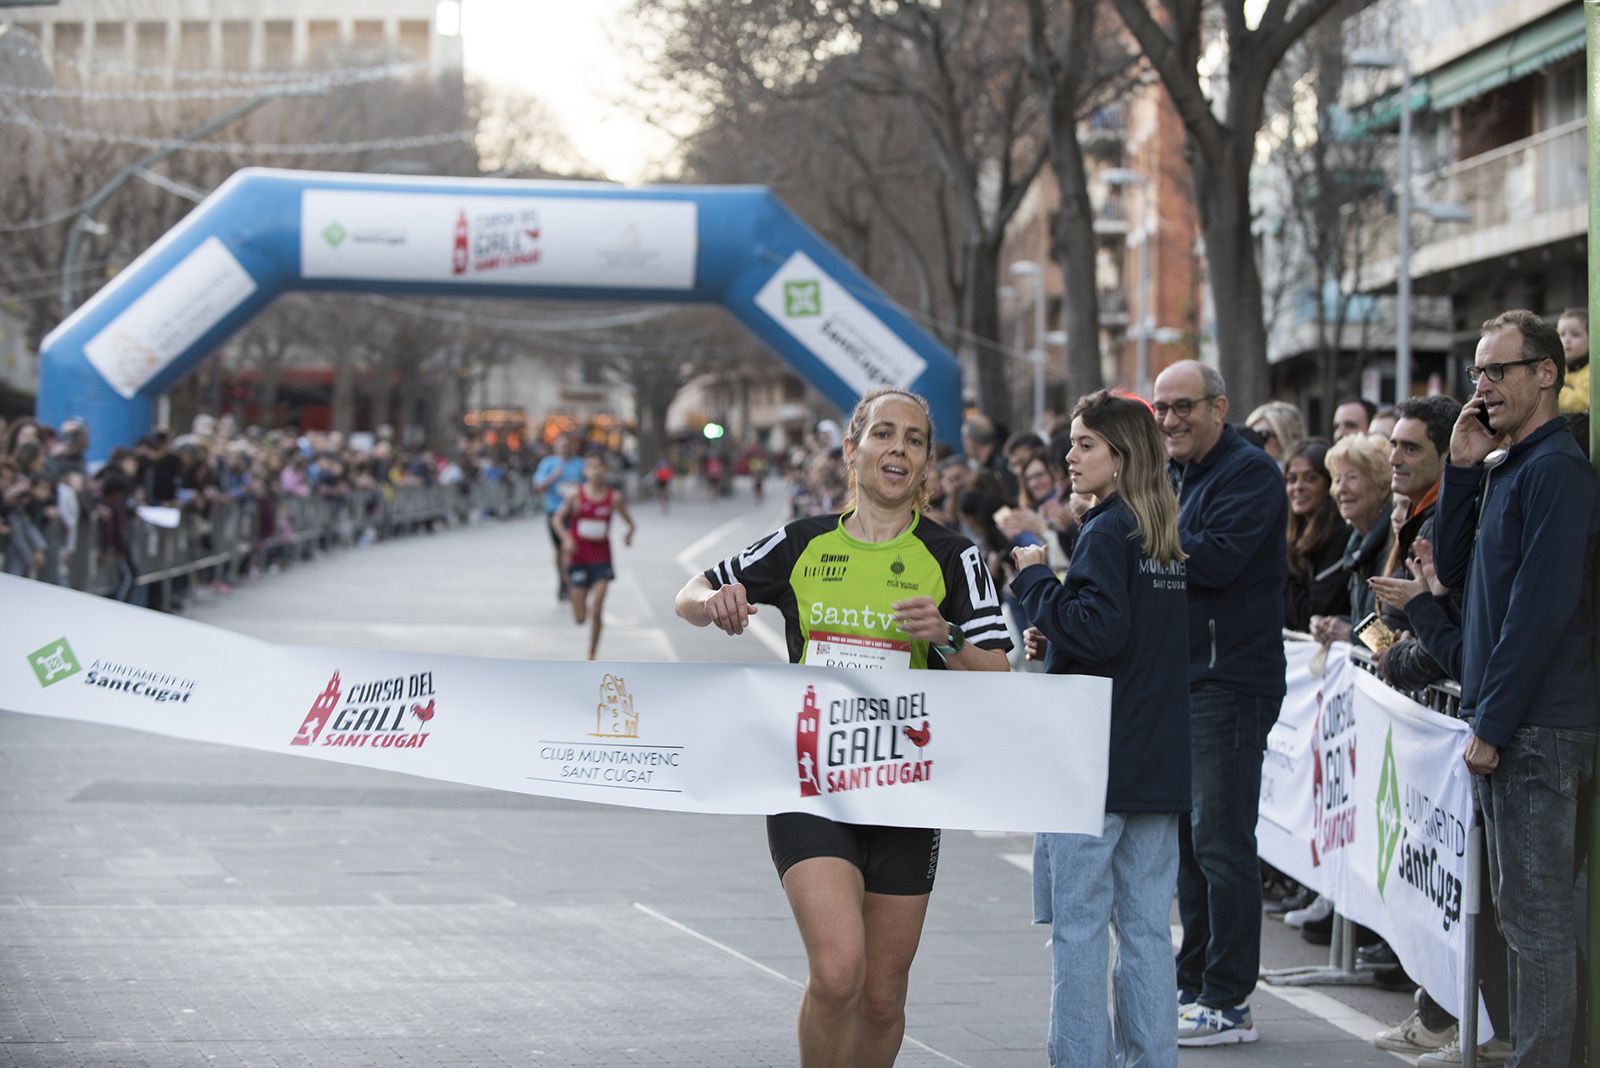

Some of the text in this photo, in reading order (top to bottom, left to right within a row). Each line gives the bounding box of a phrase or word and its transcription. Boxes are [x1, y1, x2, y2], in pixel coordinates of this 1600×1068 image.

[809, 601, 903, 634] Santv
[84, 670, 192, 704] SantCugat
[90, 658, 199, 691] AJUNTAMENT DE
[345, 670, 436, 705] CURSA DEL
[331, 703, 408, 733] GALL
[829, 691, 929, 726] CURSA DEL
[321, 732, 430, 749] SANT CUGAT
[540, 746, 680, 767] CLUB MUNTANYENC
[827, 724, 904, 767] GALL
[560, 765, 654, 784] SANT CUGAT
[827, 759, 933, 794] SANT CUGAT
[1398, 827, 1462, 932] SantCuga
